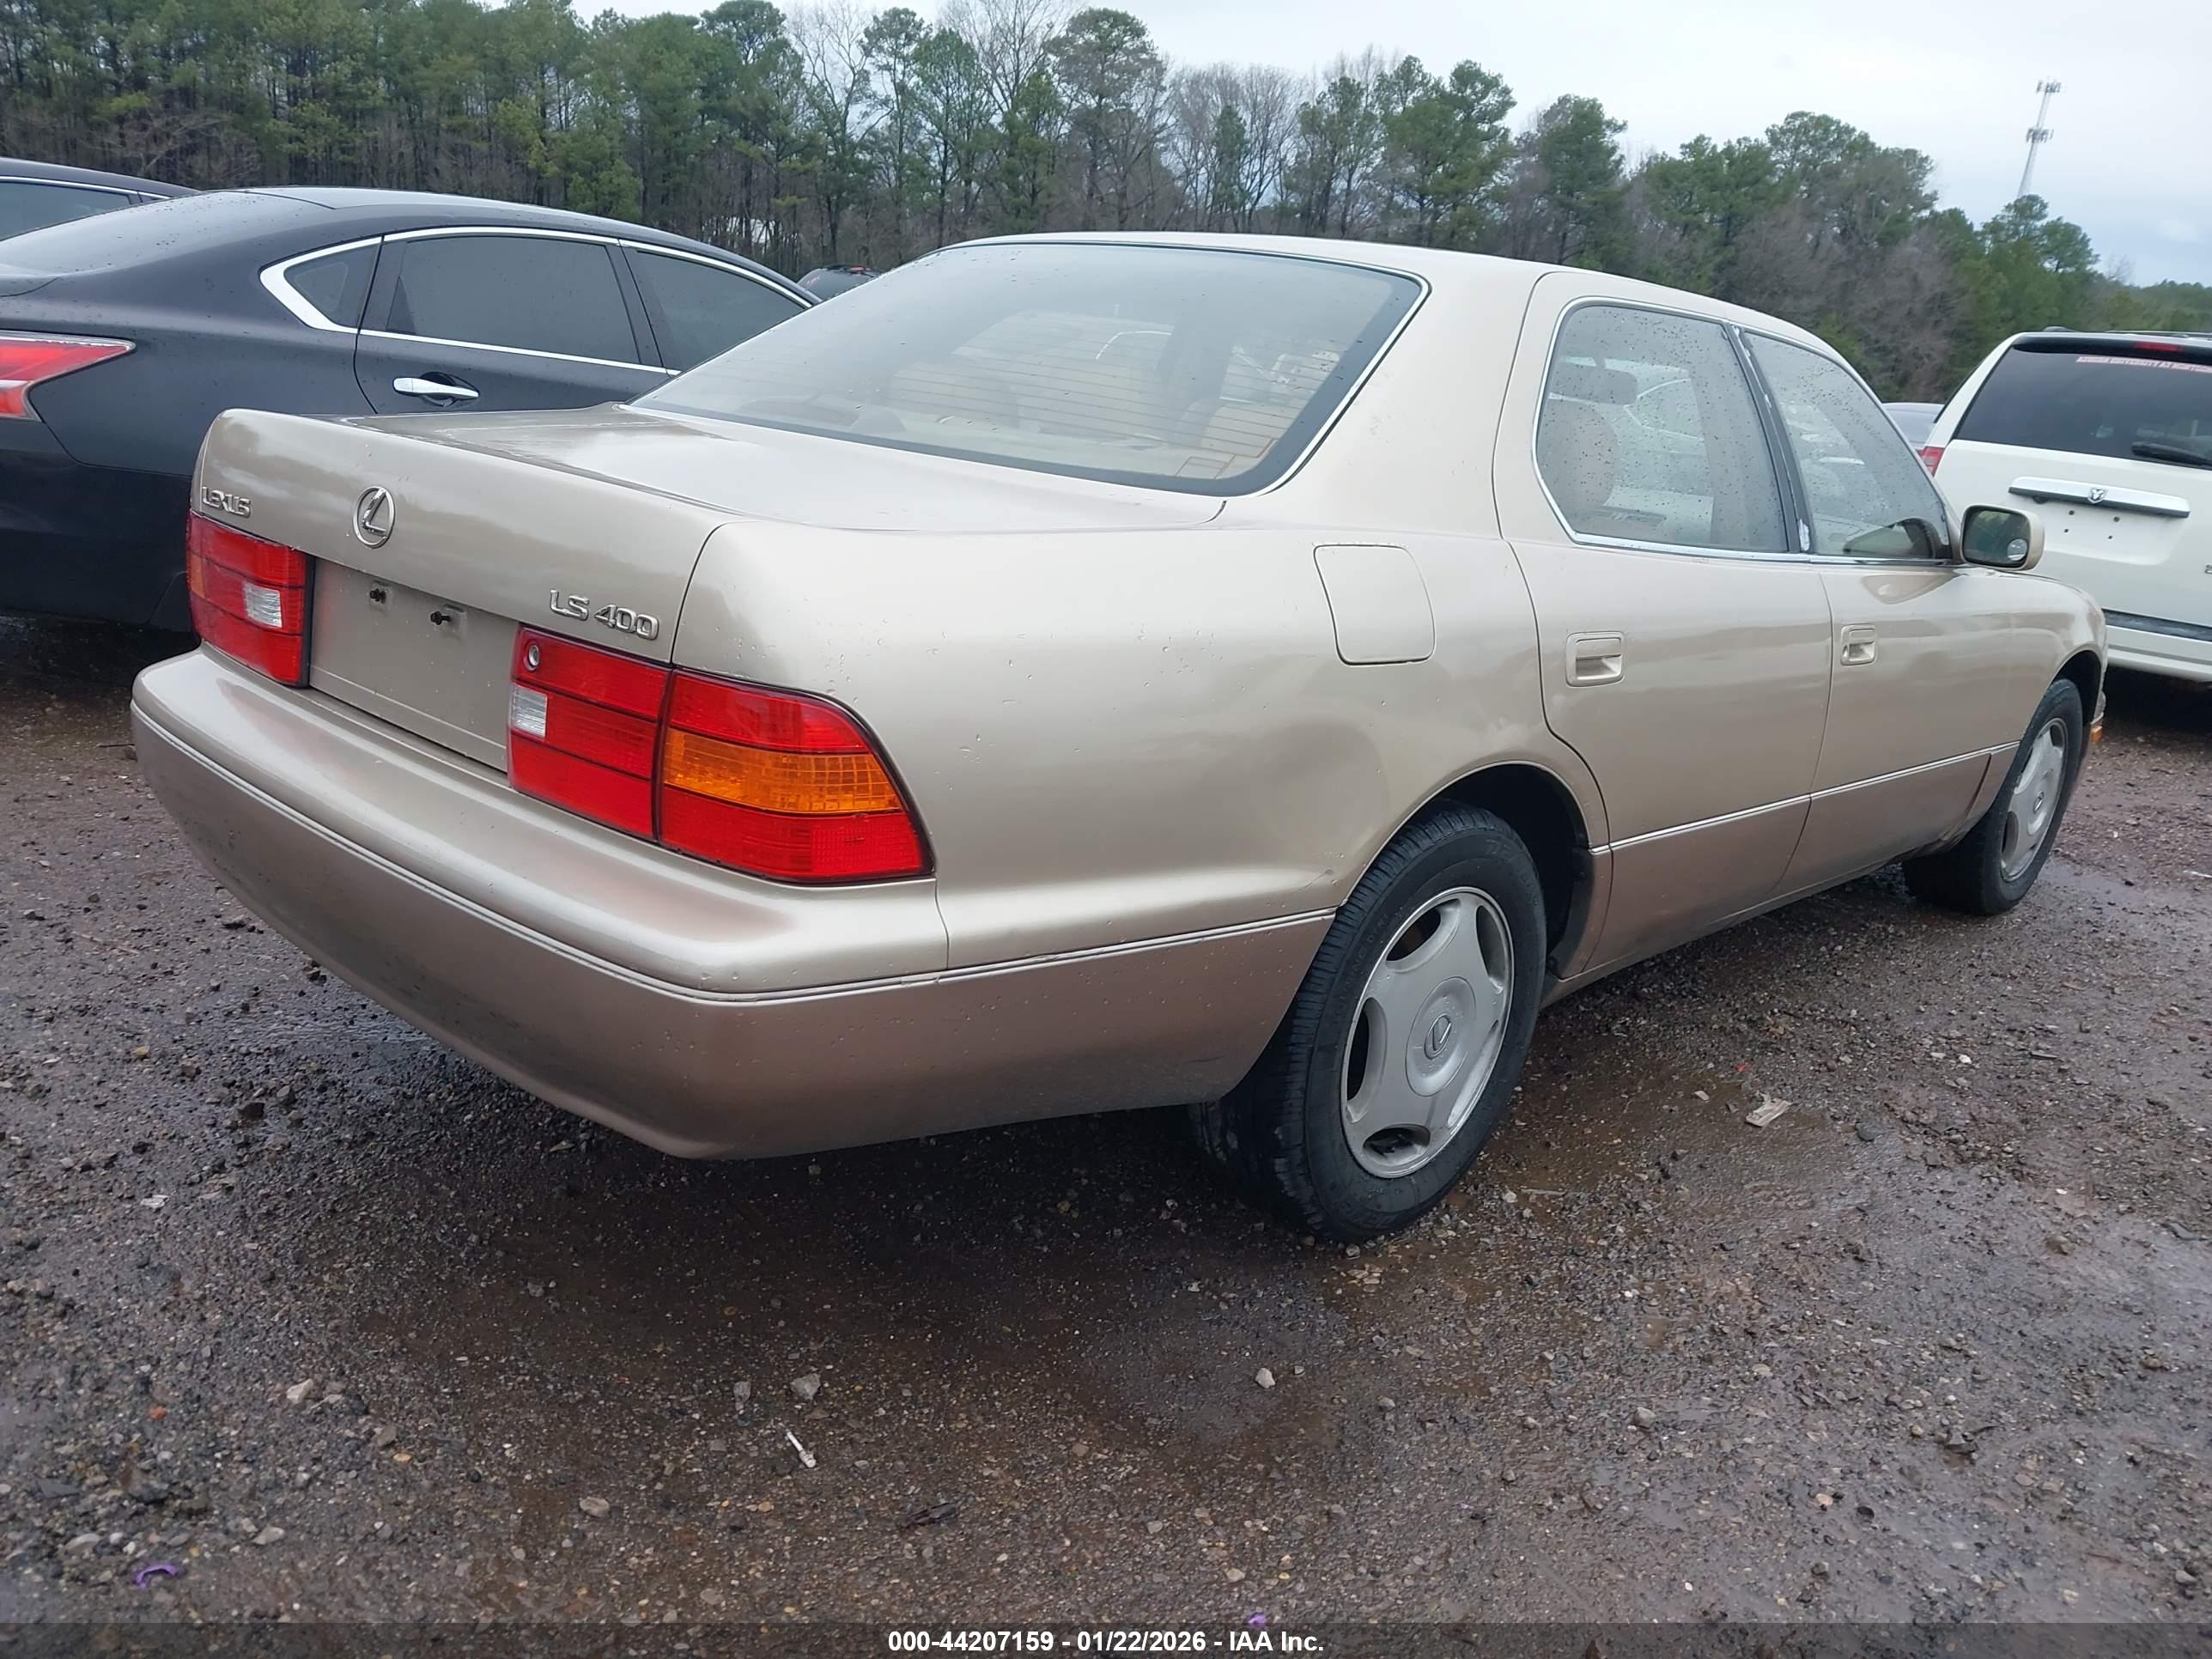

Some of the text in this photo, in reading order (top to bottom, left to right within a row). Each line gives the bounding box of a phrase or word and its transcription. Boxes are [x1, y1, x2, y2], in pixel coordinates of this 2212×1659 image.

[201, 486, 251, 518] LEXUS
[550, 589, 659, 641] LS 400
